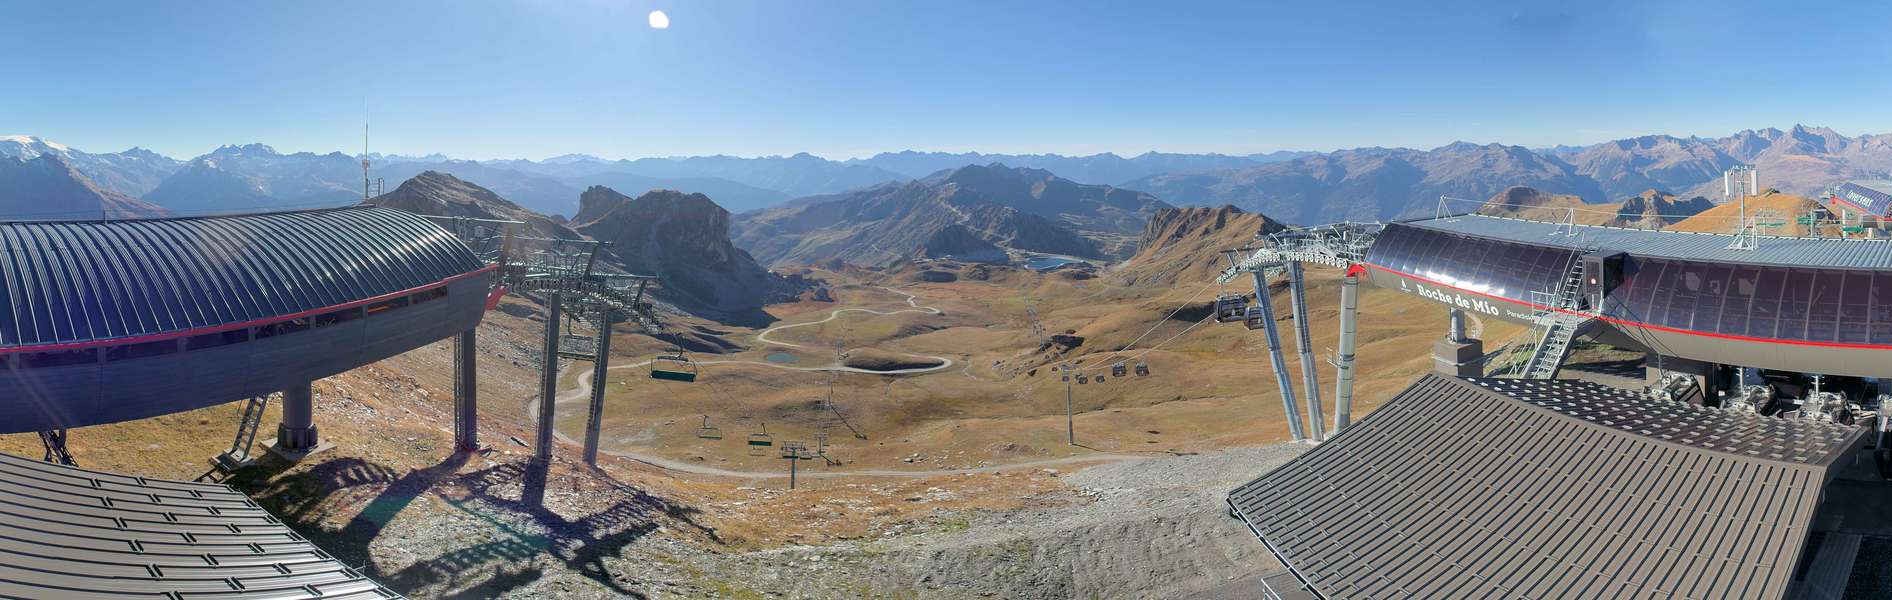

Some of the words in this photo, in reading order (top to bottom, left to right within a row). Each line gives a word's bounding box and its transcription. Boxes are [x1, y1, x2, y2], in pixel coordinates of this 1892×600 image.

[1846, 190, 1873, 207] Inversens
[1416, 283, 1452, 304] Roche
[1455, 294, 1470, 309] de
[1472, 298, 1499, 316] Mio
